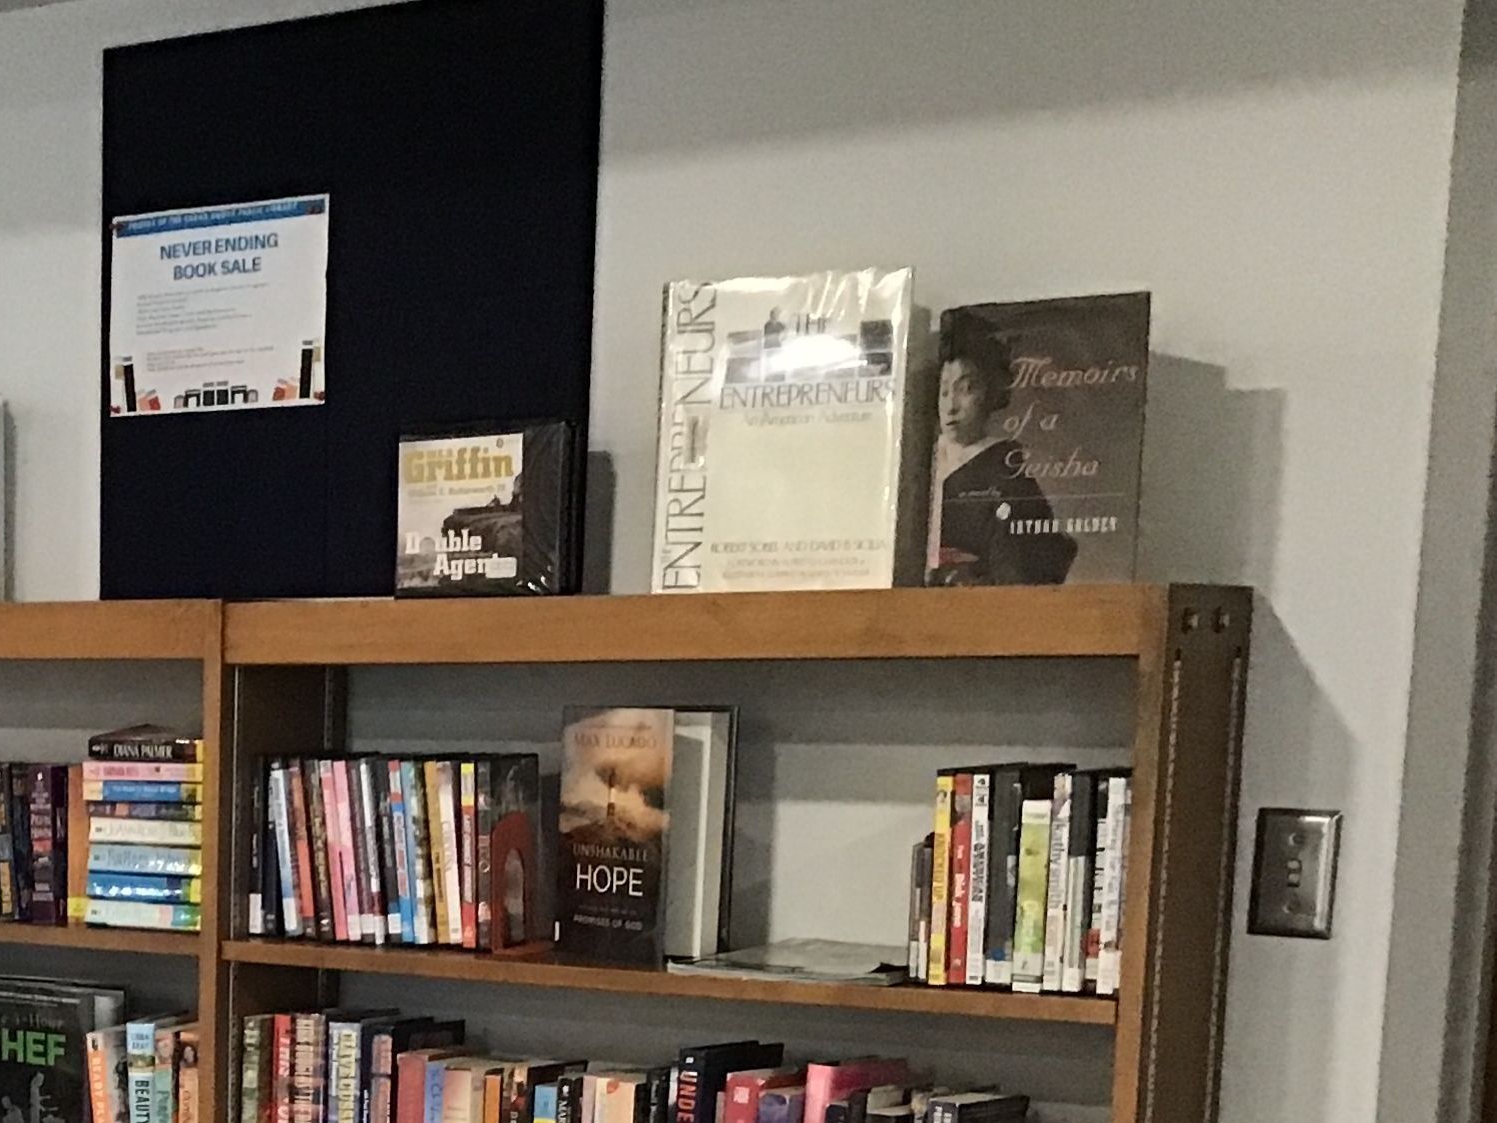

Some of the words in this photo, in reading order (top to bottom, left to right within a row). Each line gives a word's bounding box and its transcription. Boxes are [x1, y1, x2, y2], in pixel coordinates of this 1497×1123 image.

[160, 242, 212, 260] NEVER
[215, 232, 279, 256] ENDING
[173, 262, 218, 281] BOOK
[220, 256, 262, 275] SALE
[1008, 355, 1139, 389] Memoirs
[720, 380, 895, 410] ENTREPRENEURS
[1003, 400, 1036, 440] of
[1039, 413, 1058, 431] a
[405, 447, 514, 484] Griffin
[1003, 446, 1100, 480] Geisha
[1066, 516, 1118, 532] GOLDEN
[405, 528, 482, 554] Double
[113, 743, 140, 758] DIANA
[141, 744, 173, 759] PALMER
[573, 843, 648, 862] UNSHAKABLE
[576, 864, 643, 896] HOPE
[338, 1030, 356, 1078] CLIVE
[92, 1057, 103, 1097] READY
